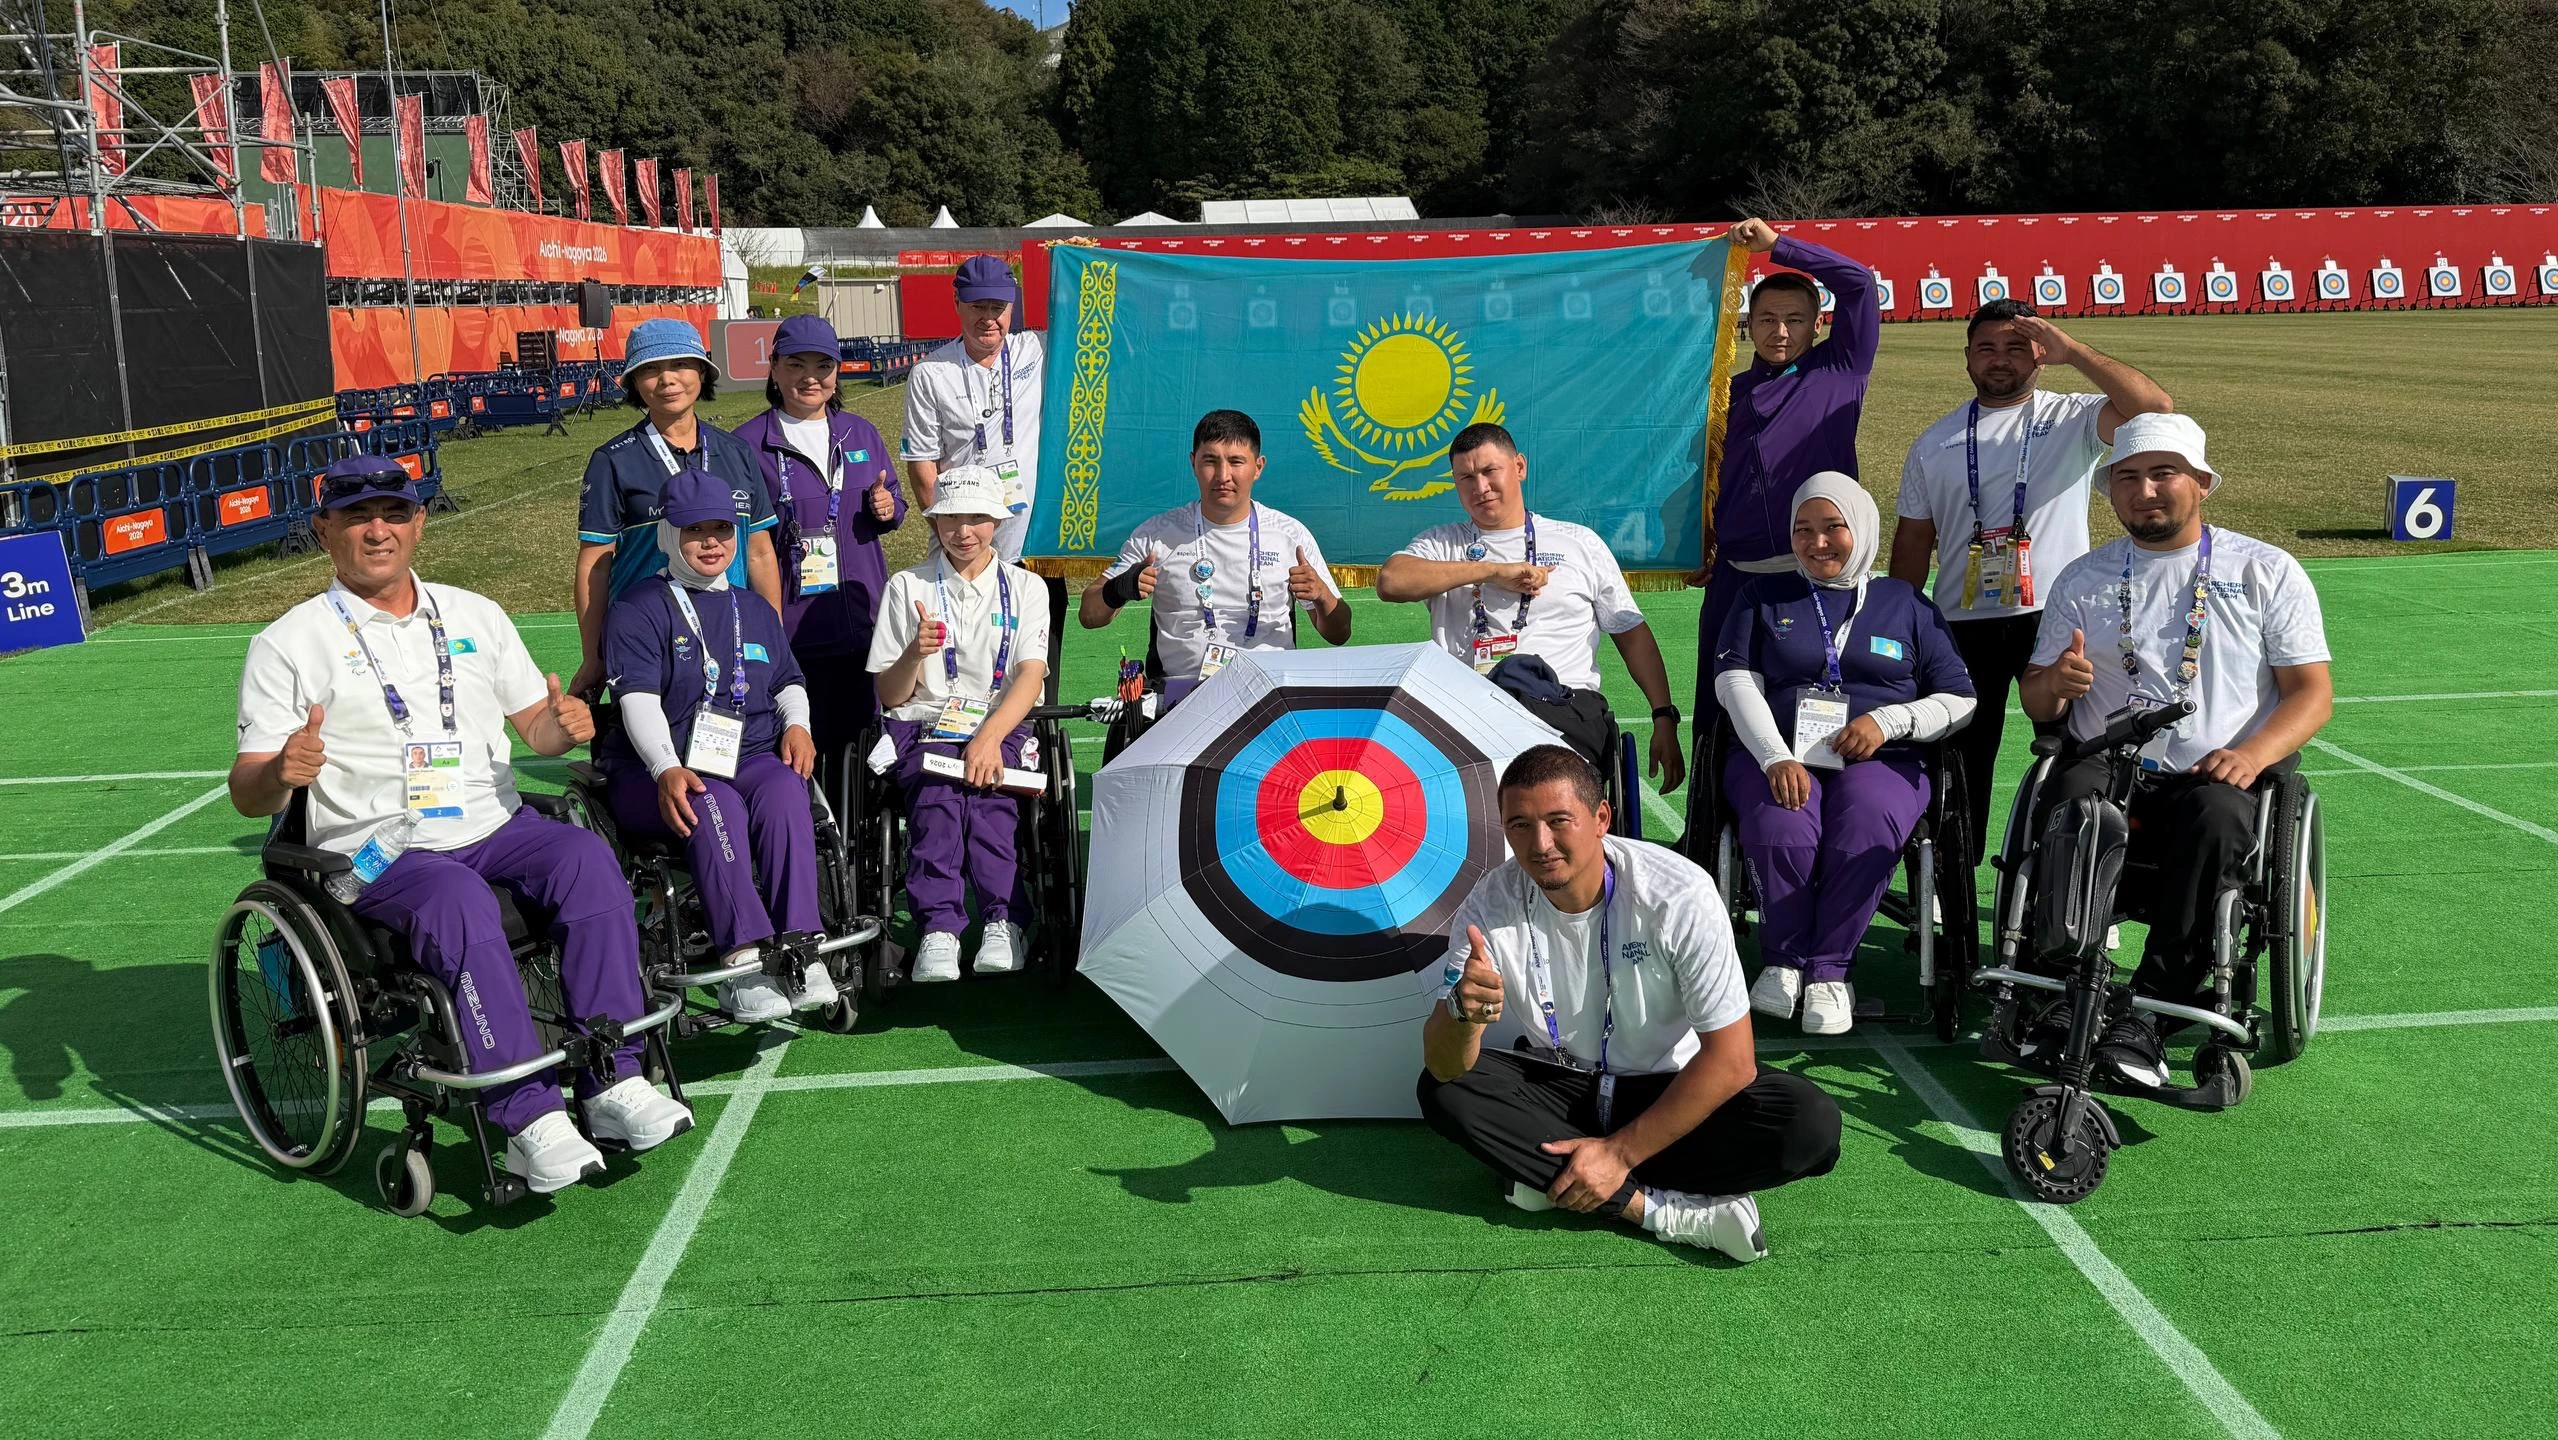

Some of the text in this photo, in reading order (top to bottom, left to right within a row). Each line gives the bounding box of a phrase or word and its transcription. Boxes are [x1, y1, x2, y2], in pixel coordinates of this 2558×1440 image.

[593, 246, 608, 262] 2026
[2405, 488, 2443, 539] 6
[116, 518, 154, 535] Aichi-Nagoya
[128, 531, 143, 541] 2026
[0, 571, 50, 599] 3m
[7, 602, 55, 623] Line
[703, 793, 735, 863] MIZUNO
[460, 971, 496, 1050] MIZUNO
